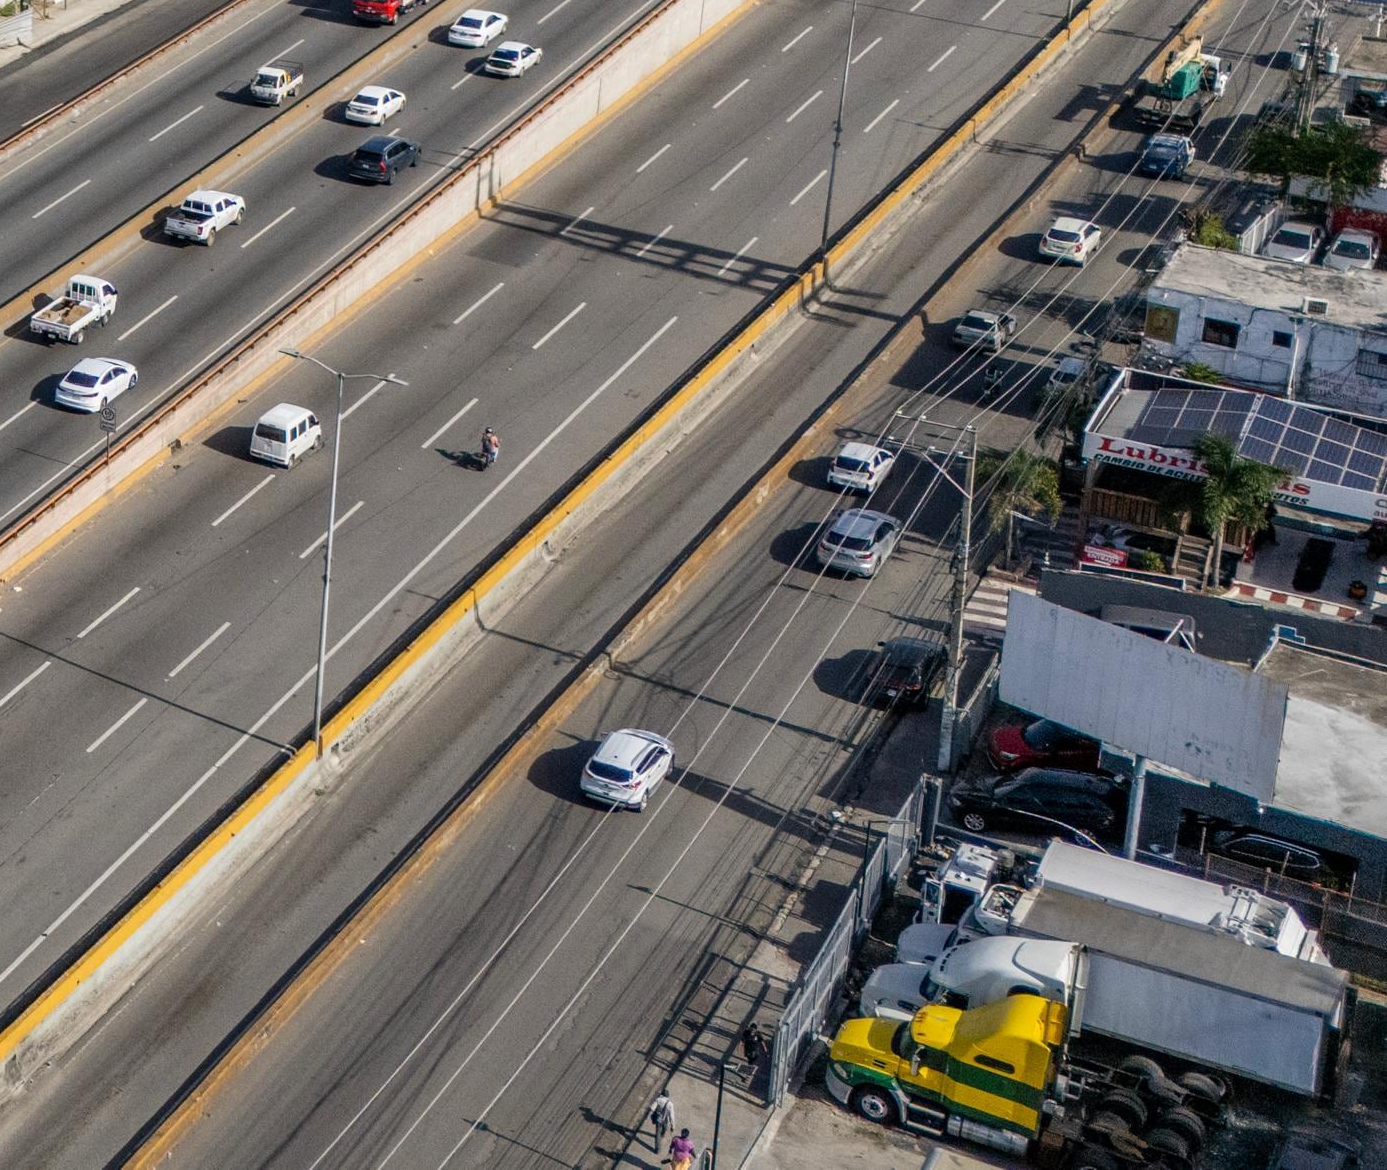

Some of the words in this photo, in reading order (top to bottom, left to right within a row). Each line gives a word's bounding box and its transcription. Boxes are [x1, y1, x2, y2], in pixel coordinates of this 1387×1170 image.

[1094, 453, 1144, 469] CAMBIO
[1147, 464, 1164, 475] DE
[1165, 469, 1205, 482] ACEIT
